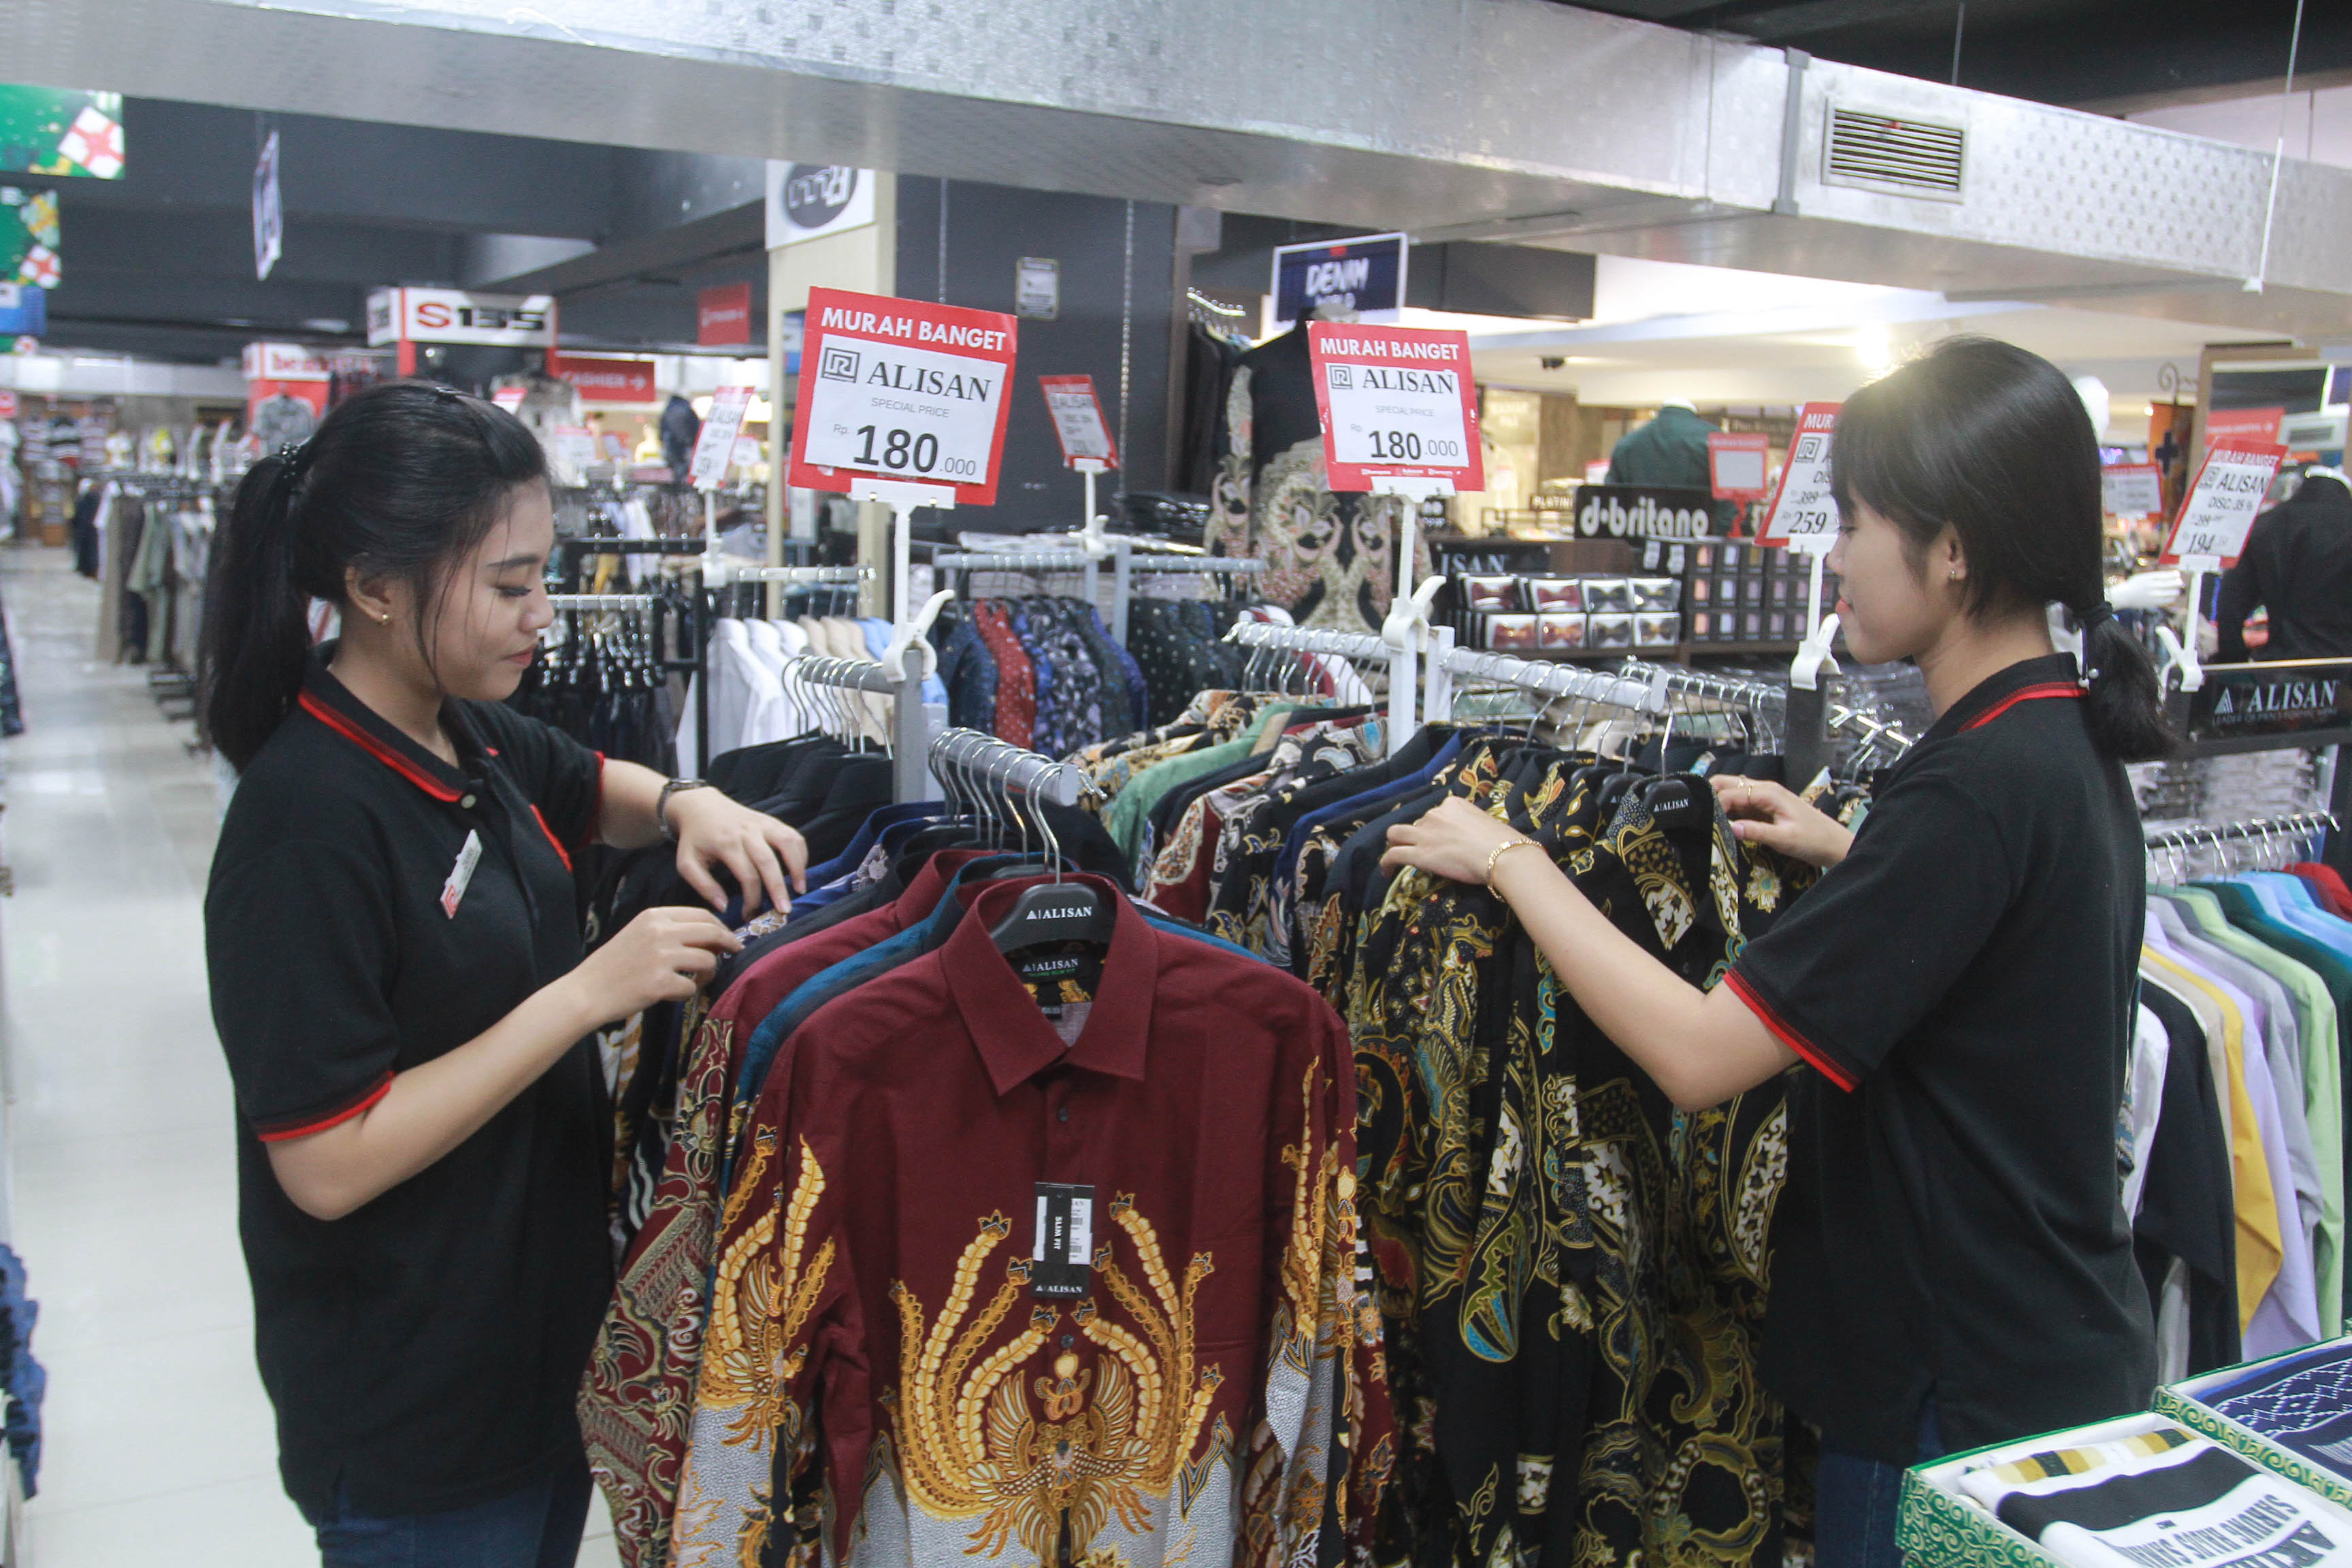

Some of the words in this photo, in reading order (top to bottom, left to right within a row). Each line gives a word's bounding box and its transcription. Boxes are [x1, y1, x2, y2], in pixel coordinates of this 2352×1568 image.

[821, 307, 913, 338] MURAH
[918, 321, 1007, 351] BANGET
[1320, 338, 1387, 357] MURAH
[1392, 341, 1459, 361] BANGET
[866, 361, 992, 402] ALISAN
[1362, 369, 1454, 395] ALISAN
[871, 397, 916, 413] SPECIAL
[918, 404, 951, 419] PRICE
[1375, 405, 1409, 416] SPECIAL
[1410, 408, 1435, 418] PRICE
[833, 423, 849, 436] Rp.
[1804, 413, 1834, 429] MUR
[2217, 472, 2271, 495] ALISAN
[1788, 511, 1827, 534] 259
[1441, 553, 1509, 576] ISAN
[2247, 679, 2341, 713] ALISAN
[1663, 798, 1689, 811] ALISAN
[1043, 906, 1092, 919] ALISAN
[1036, 958, 1079, 972] ALISAN
[1054, 1215, 1063, 1238] SLIM
[1047, 1284, 1083, 1294] ALISAN
[2219, 1493, 2300, 1545] SARUNG
[2172, 1526, 2243, 1561] HALUS
